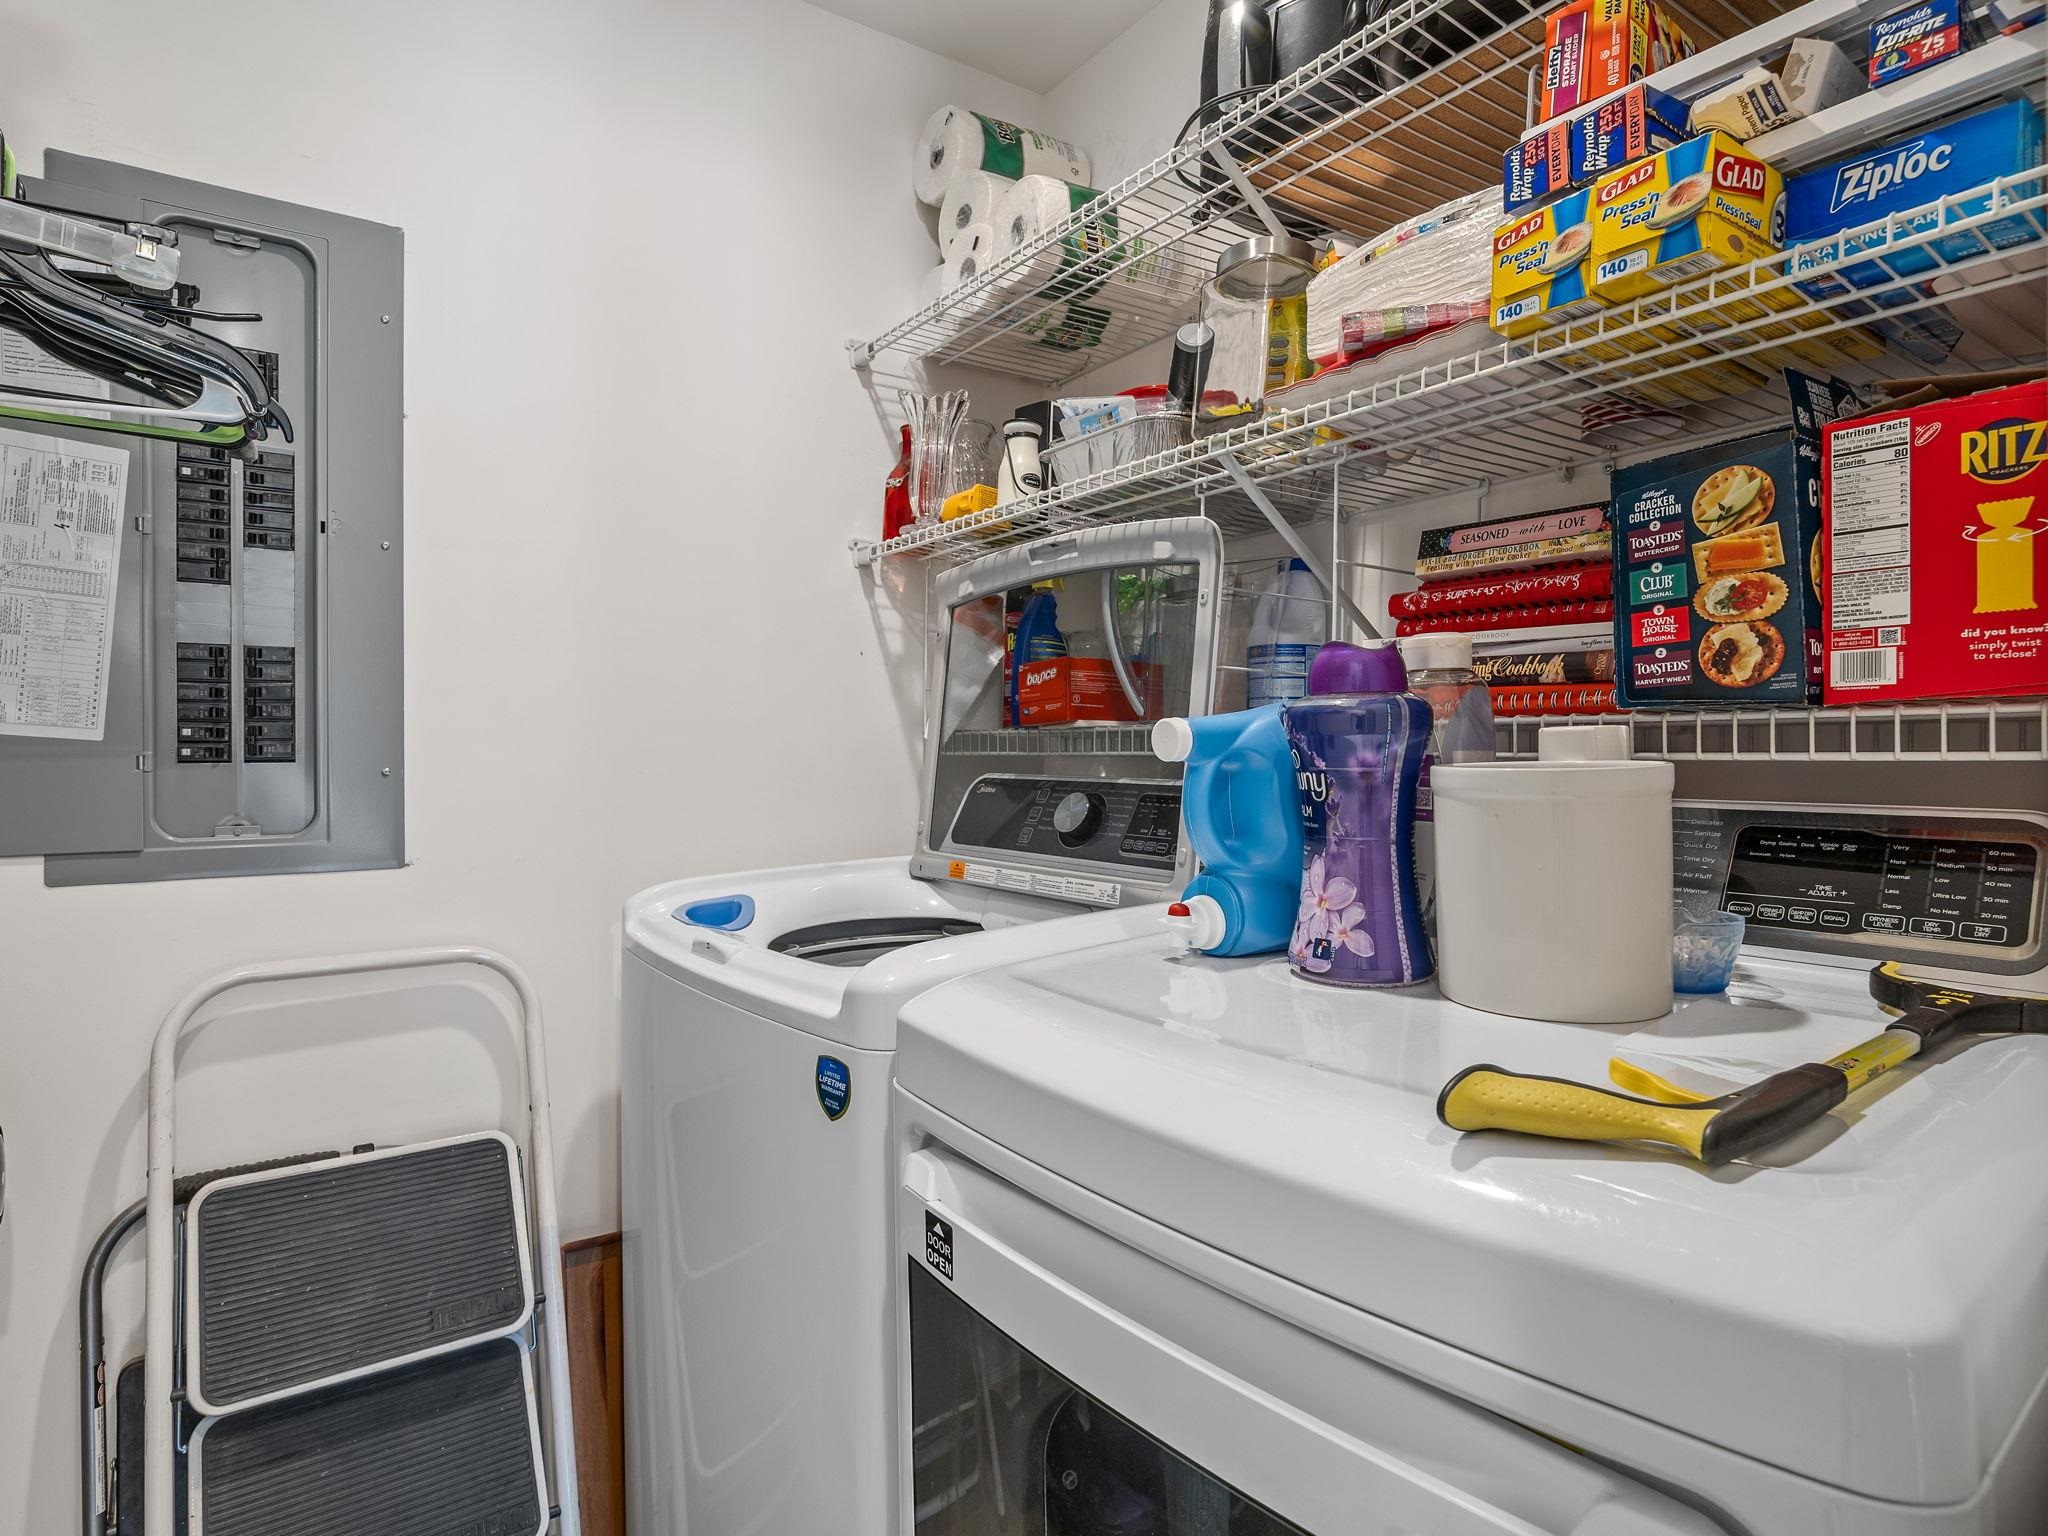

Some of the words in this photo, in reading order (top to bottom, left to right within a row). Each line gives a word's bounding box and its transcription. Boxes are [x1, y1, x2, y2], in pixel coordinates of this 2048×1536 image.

[1876, 7, 1932, 36] Reynolds
[1875, 13, 1947, 51] CUT-RITE
[1874, 47, 1894, 58] WAX
[1894, 35, 1922, 50] PAPER
[1921, 34, 1945, 53] 75
[1548, 46, 1562, 87] Hefty
[1562, 37, 1572, 87] STORAGE
[1570, 60, 1578, 85] QUART
[1608, 73, 1619, 86] 40
[1613, 100, 1622, 112] FT
[1736, 95, 1748, 117] Paper
[1599, 105, 1613, 132] 250
[1613, 113, 1623, 127] SQ
[1629, 95, 1641, 151] EVERYDAY
[1538, 136, 1545, 147] FT
[1583, 116, 1595, 171] Reynolds
[1595, 134, 1611, 169] Wrap
[1525, 139, 1537, 167] 250
[1538, 147, 1546, 160] SQ
[1552, 130, 1562, 183] EVERYDAY
[1510, 150, 1521, 201] Reynolds
[1716, 156, 1764, 191] GLAD
[1841, 144, 1952, 202] Ziploc
[1521, 167, 1533, 200] Wrap
[1600, 166, 1652, 202] GLAD
[1602, 192, 1660, 222] Press'n
[1716, 196, 1744, 225] Press'n
[1744, 212, 1762, 231] Seal
[1620, 205, 1657, 230] Seal
[1497, 216, 1541, 251] GLAD
[1499, 241, 1549, 268] Press'n
[1516, 253, 1547, 275] Seal
[1600, 259, 1628, 279] 140
[1499, 303, 1523, 321] 140
[1833, 427, 1877, 441] Nutrition
[1880, 421, 1909, 432] Facts
[1917, 423, 1940, 445] NABISCO
[1961, 421, 2048, 474] RITZ
[1833, 459, 1867, 469] Calories
[1894, 448, 1908, 458] 80
[1990, 465, 2029, 475] CRACKERS
[1634, 495, 1675, 513] CRACKER
[1641, 488, 1667, 500] Kellogg's
[1629, 504, 1682, 524] COLLECTION
[1461, 528, 1509, 545] SEASONED
[1519, 522, 1545, 536] with
[1558, 515, 1586, 530] LOVE
[1630, 531, 1682, 549] TOASTEDS
[1421, 557, 1443, 566] FIX-IT
[1444, 554, 1458, 562] and
[1458, 548, 1495, 561] FORGET-IT
[1498, 542, 1540, 555] COOKBOOK
[1634, 545, 1680, 558] BUTTERCRISP
[1426, 562, 1453, 573] Feasting
[1456, 560, 1470, 568] with
[1471, 559, 1487, 568] your
[1489, 555, 1505, 564] Slow
[1507, 551, 1532, 561] Cooker
[1640, 575, 1673, 592] CLUB
[1641, 591, 1674, 600] ORIGINAL
[1641, 616, 1675, 628] TOWN
[1642, 625, 1677, 637] HOUSE
[1961, 628, 1981, 638] did
[1984, 628, 2007, 639] you
[2010, 624, 2048, 635] know?
[1471, 632, 1510, 640] COOKBOOK
[1643, 634, 1676, 643] ORIGINAL
[1969, 640, 2008, 652] simply
[2012, 638, 2042, 648] twist
[1974, 652, 1986, 660] to
[1989, 648, 2037, 660] reclose!
[1493, 653, 1565, 677] Cookbook
[1635, 663, 1688, 676] TOASTEDS
[1027, 667, 1057, 686] bounce
[1635, 677, 1665, 686] HARVEST
[1666, 675, 1691, 684] WHEAT
[977, 783, 996, 793] Midea
[1683, 841, 1703, 849] Quick
[1807, 890, 1838, 898] ADJUST
[1869, 916, 1899, 924] DRYNESS
[819, 1075, 846, 1090] LIFETIME
[824, 1070, 840, 1080] LIMITED
[821, 1083, 845, 1097] WARRANTY
[927, 1232, 951, 1259] DOOR
[927, 1250, 952, 1277] OPEN
